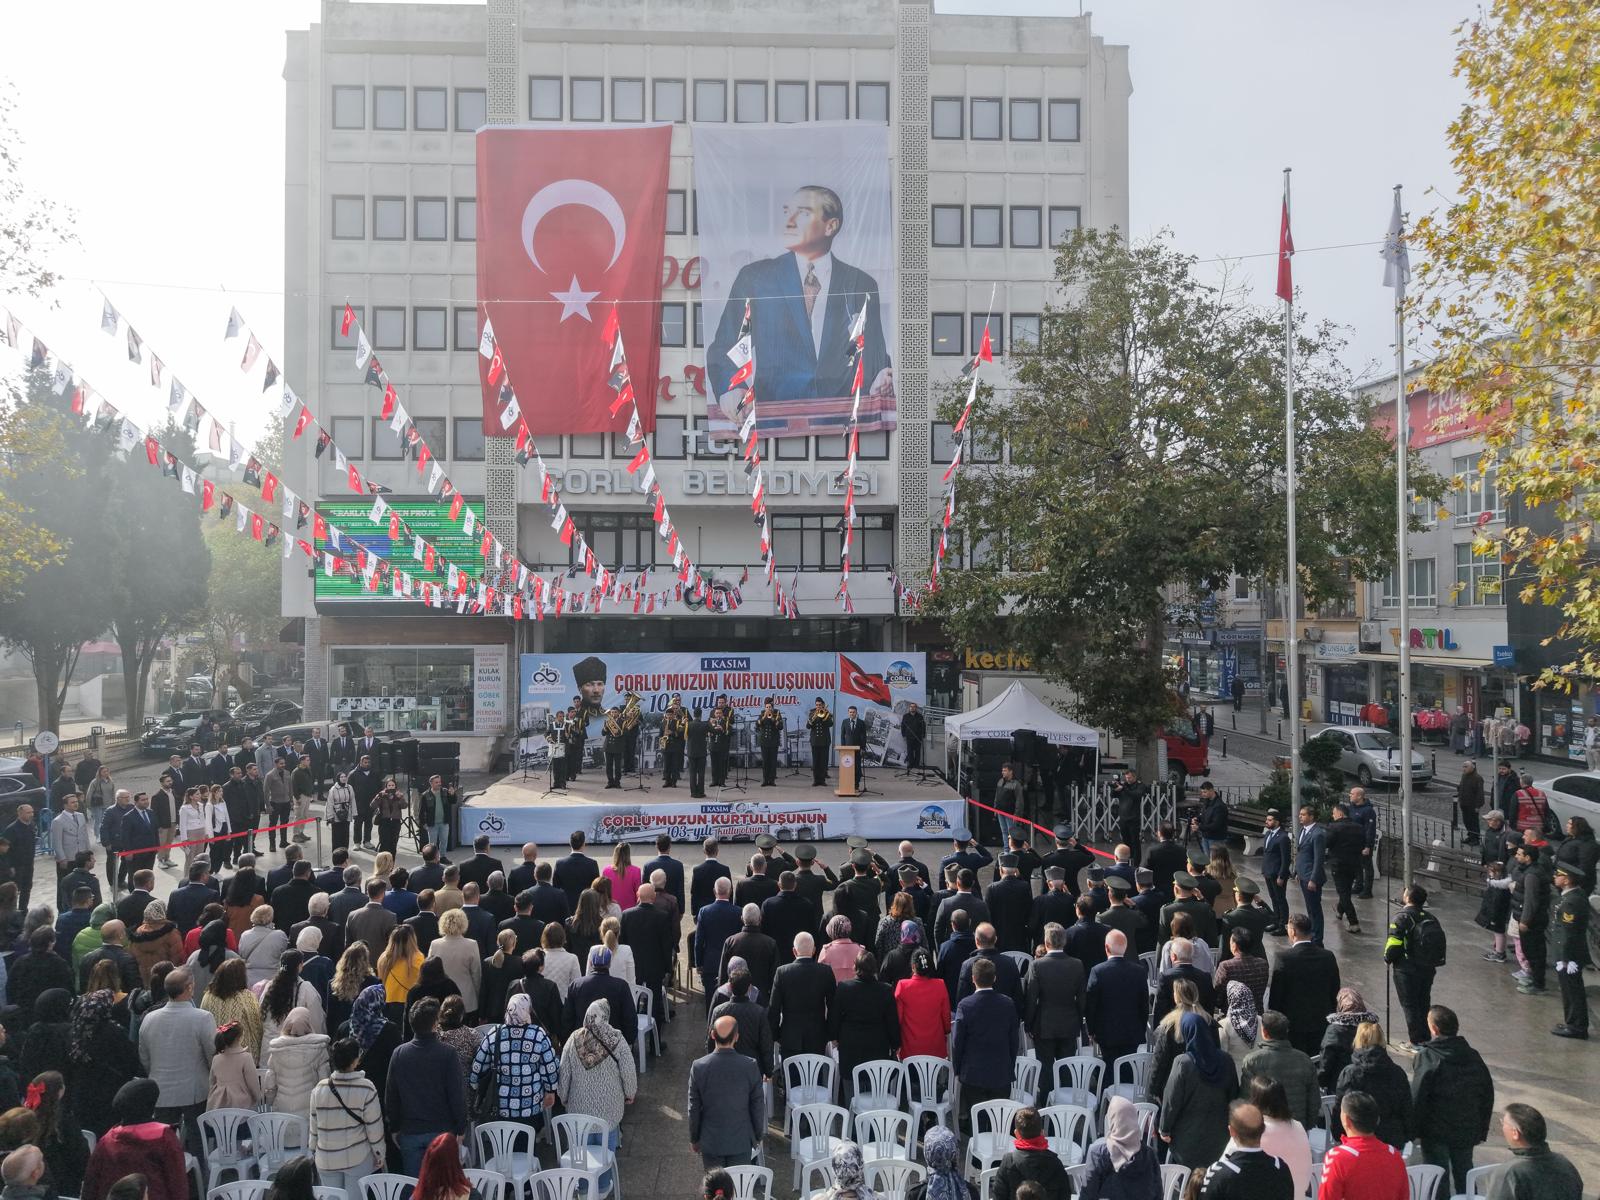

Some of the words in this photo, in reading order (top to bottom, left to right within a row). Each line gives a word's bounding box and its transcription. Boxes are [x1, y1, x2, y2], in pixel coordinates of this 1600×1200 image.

[1389, 628, 1458, 650] TRTIL
[711, 660, 747, 669] KASIM
[614, 672, 718, 694] ÇORLU'MUZUN
[723, 672, 835, 693] KURTULUŞUNUN
[602, 814, 708, 829] ÇORLU'MUZUN
[711, 813, 828, 826] KURTULUŞUNUN
[667, 825, 690, 838] 103.
